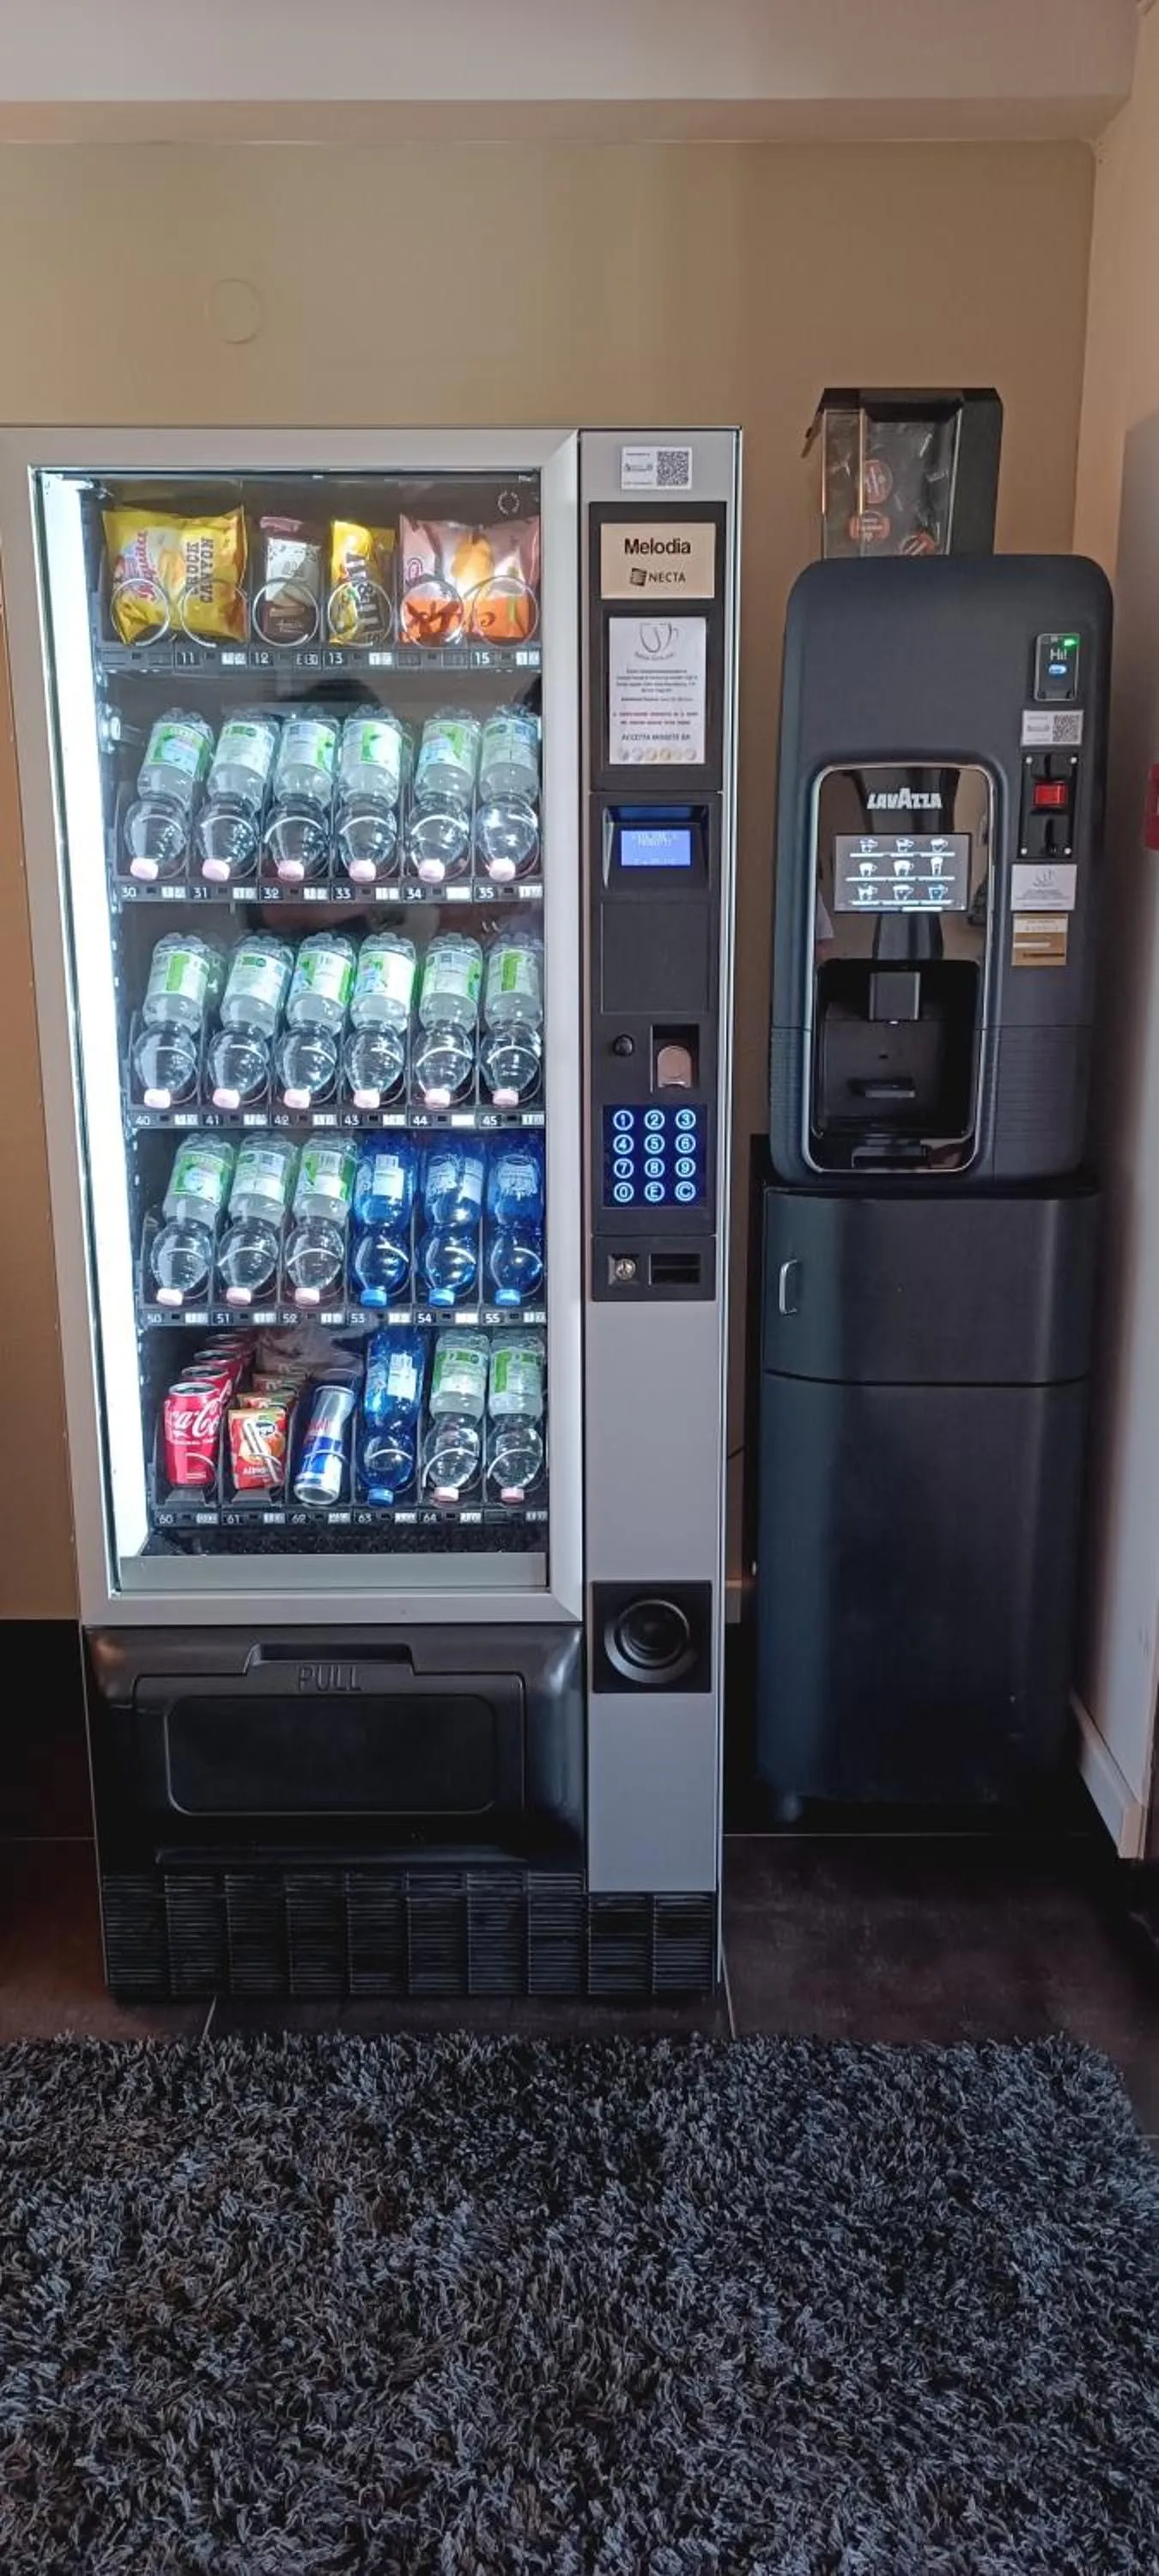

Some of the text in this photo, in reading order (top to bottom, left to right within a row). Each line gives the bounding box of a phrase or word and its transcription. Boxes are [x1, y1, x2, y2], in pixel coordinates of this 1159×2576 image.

[624, 537, 691, 555] Melodia
[649, 571, 686, 583] NECTA
[179, 652, 195, 665] 11
[255, 652, 269, 665] 12
[329, 652, 343, 665] 13
[475, 652, 490, 665] 15
[1049, 648, 1067, 660] Hi!
[866, 787, 943, 810] LAVAZZA
[121, 887, 137, 899] 30
[193, 887, 207, 899] 31
[264, 887, 279, 899] 32
[335, 887, 350, 899] 33
[407, 887, 422, 899] 34
[478, 887, 495, 899] 35
[135, 1115, 150, 1126] 40
[205, 1115, 218, 1126] 41
[274, 1115, 289, 1126] 42
[344, 1115, 359, 1126] 43
[413, 1115, 428, 1126] 44
[482, 1115, 497, 1126] 45
[147, 1312, 162, 1323] 50
[215, 1312, 229, 1323] 51
[282, 1312, 297, 1323] 52
[350, 1312, 365, 1323] 53
[416, 1312, 432, 1323] 54
[485, 1312, 500, 1323] 55
[298, 1664, 361, 1692] PULL
